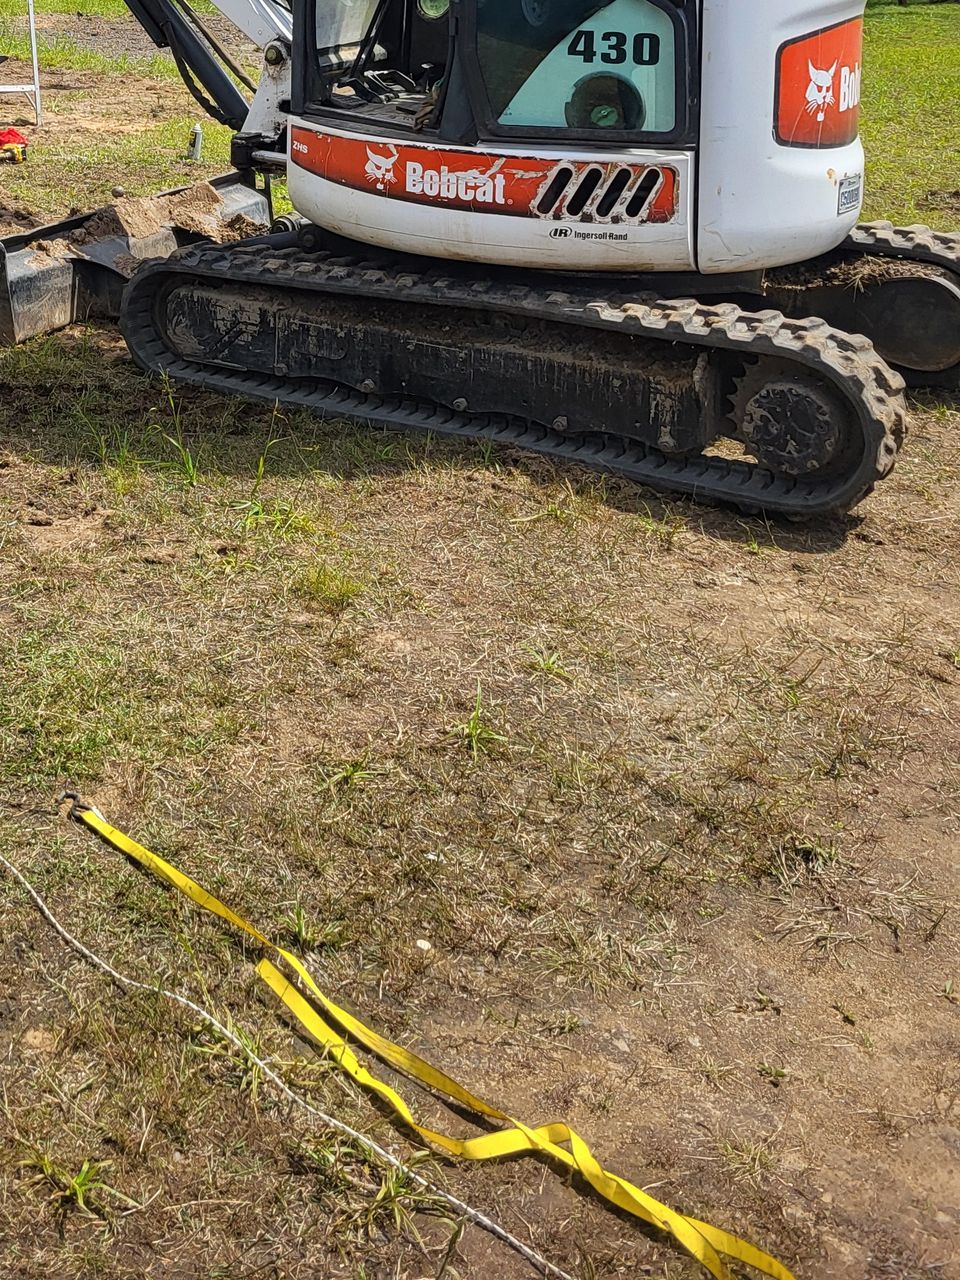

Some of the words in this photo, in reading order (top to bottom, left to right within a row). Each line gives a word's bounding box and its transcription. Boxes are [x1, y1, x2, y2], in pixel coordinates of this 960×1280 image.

[567, 29, 660, 66] 430
[839, 61, 861, 112] Bob
[292, 140, 308, 154] ZHS
[405, 161, 506, 205] Bobcat
[552, 227, 570, 238] IR
